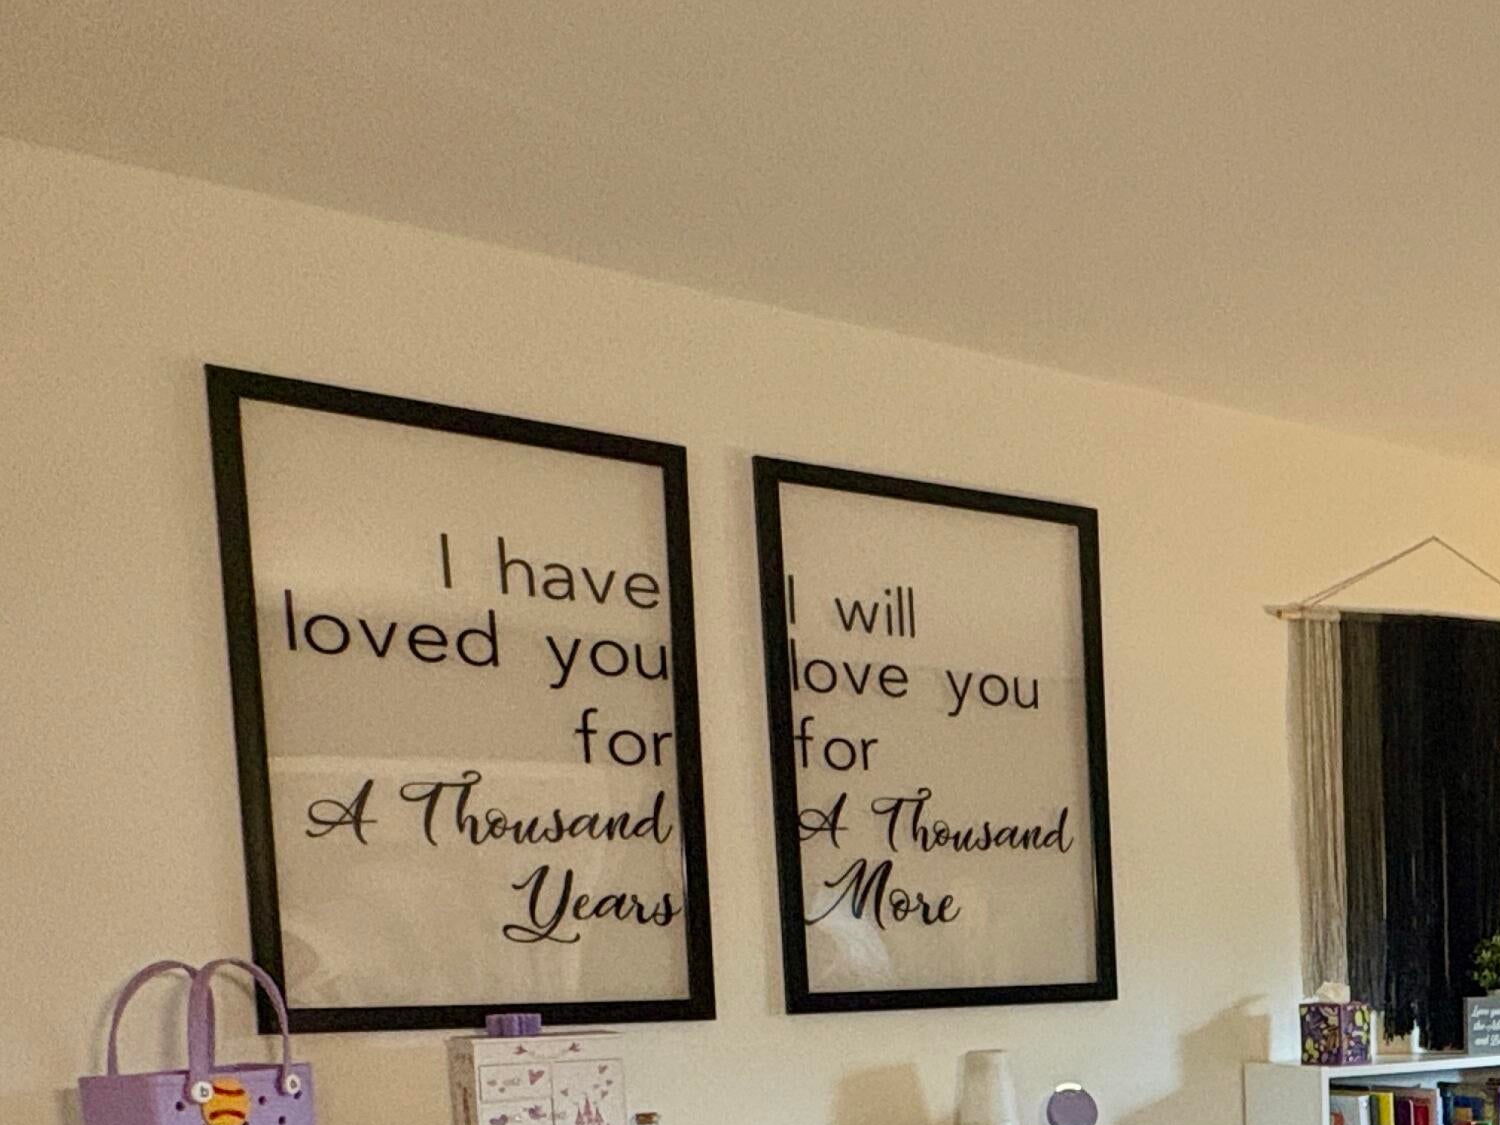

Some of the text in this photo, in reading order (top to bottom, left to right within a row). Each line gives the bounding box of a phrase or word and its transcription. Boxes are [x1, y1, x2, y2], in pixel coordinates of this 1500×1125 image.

[440, 533, 662, 609] I have
[787, 574, 916, 639] I will
[284, 589, 670, 689] loved you
[789, 637, 1040, 717] love you
[574, 707, 674, 767] for
[793, 716, 878, 771] for
[305, 770, 675, 846] A Thousand
[799, 787, 1075, 854] A Thousand
[503, 865, 682, 943] Years
[803, 858, 962, 931] More
